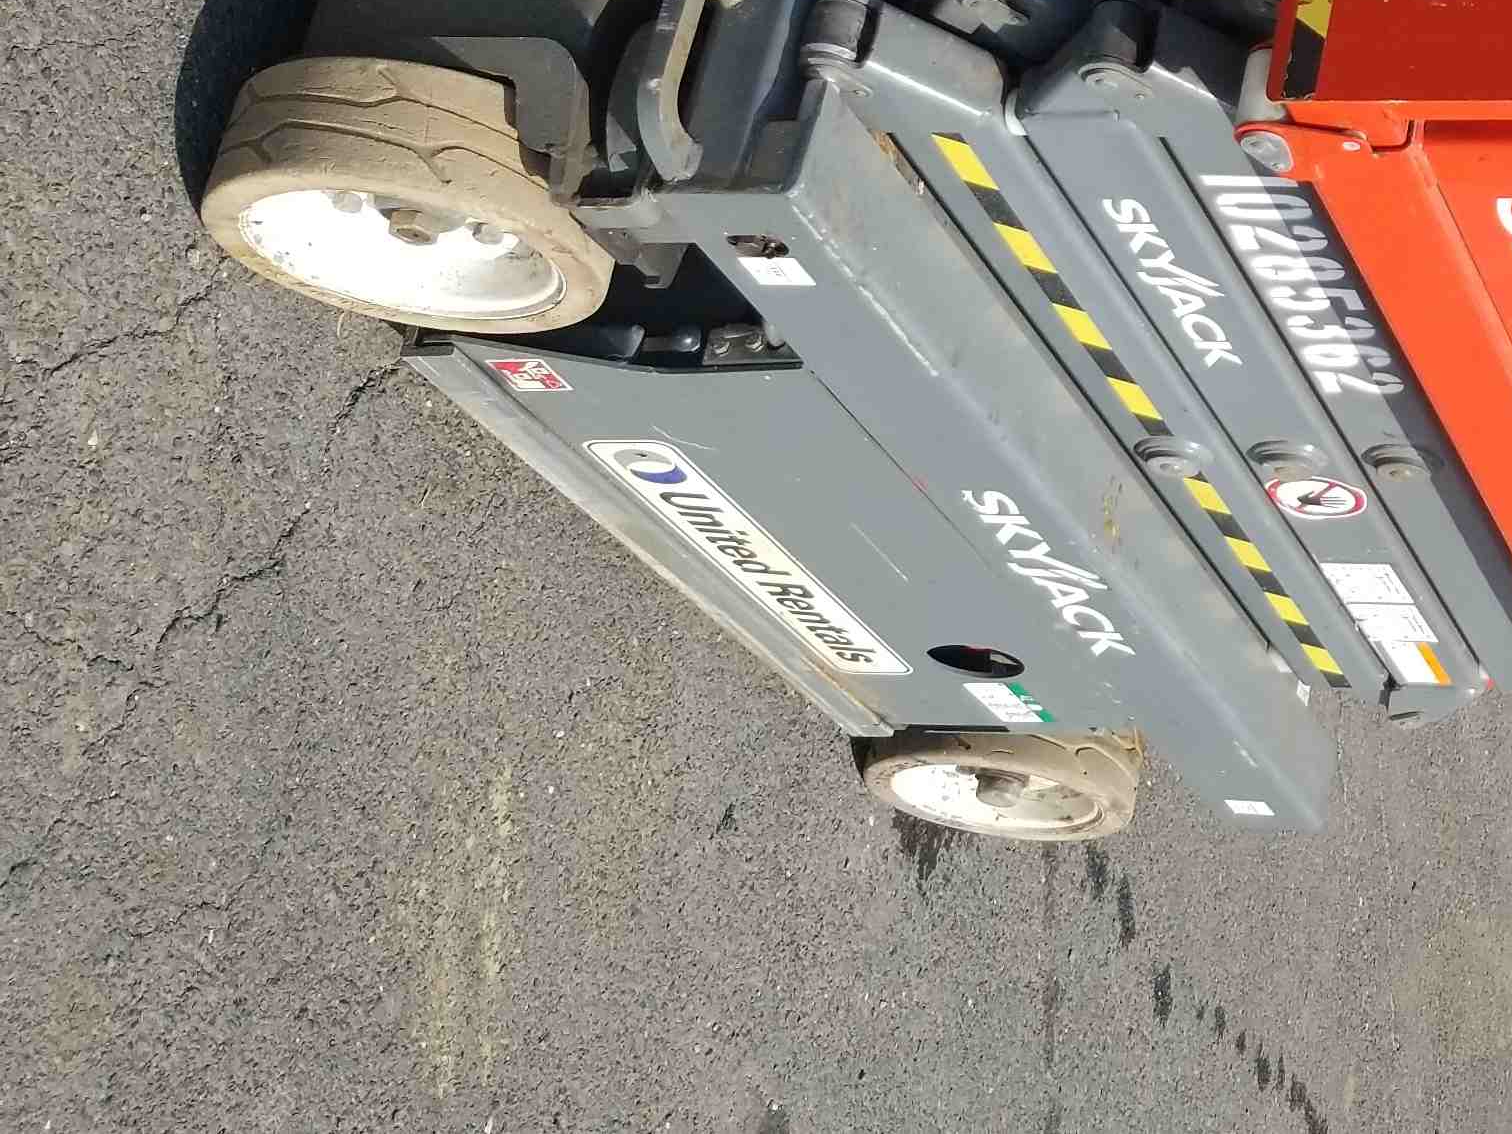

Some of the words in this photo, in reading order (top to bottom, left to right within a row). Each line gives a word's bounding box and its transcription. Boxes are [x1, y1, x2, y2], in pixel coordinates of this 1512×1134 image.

[1102, 198, 1243, 368] SKYJACK
[1199, 174, 1405, 395] 10285362
[658, 491, 777, 575] United
[756, 570, 874, 664] Rentals
[960, 489, 1136, 657] SKYJACK
